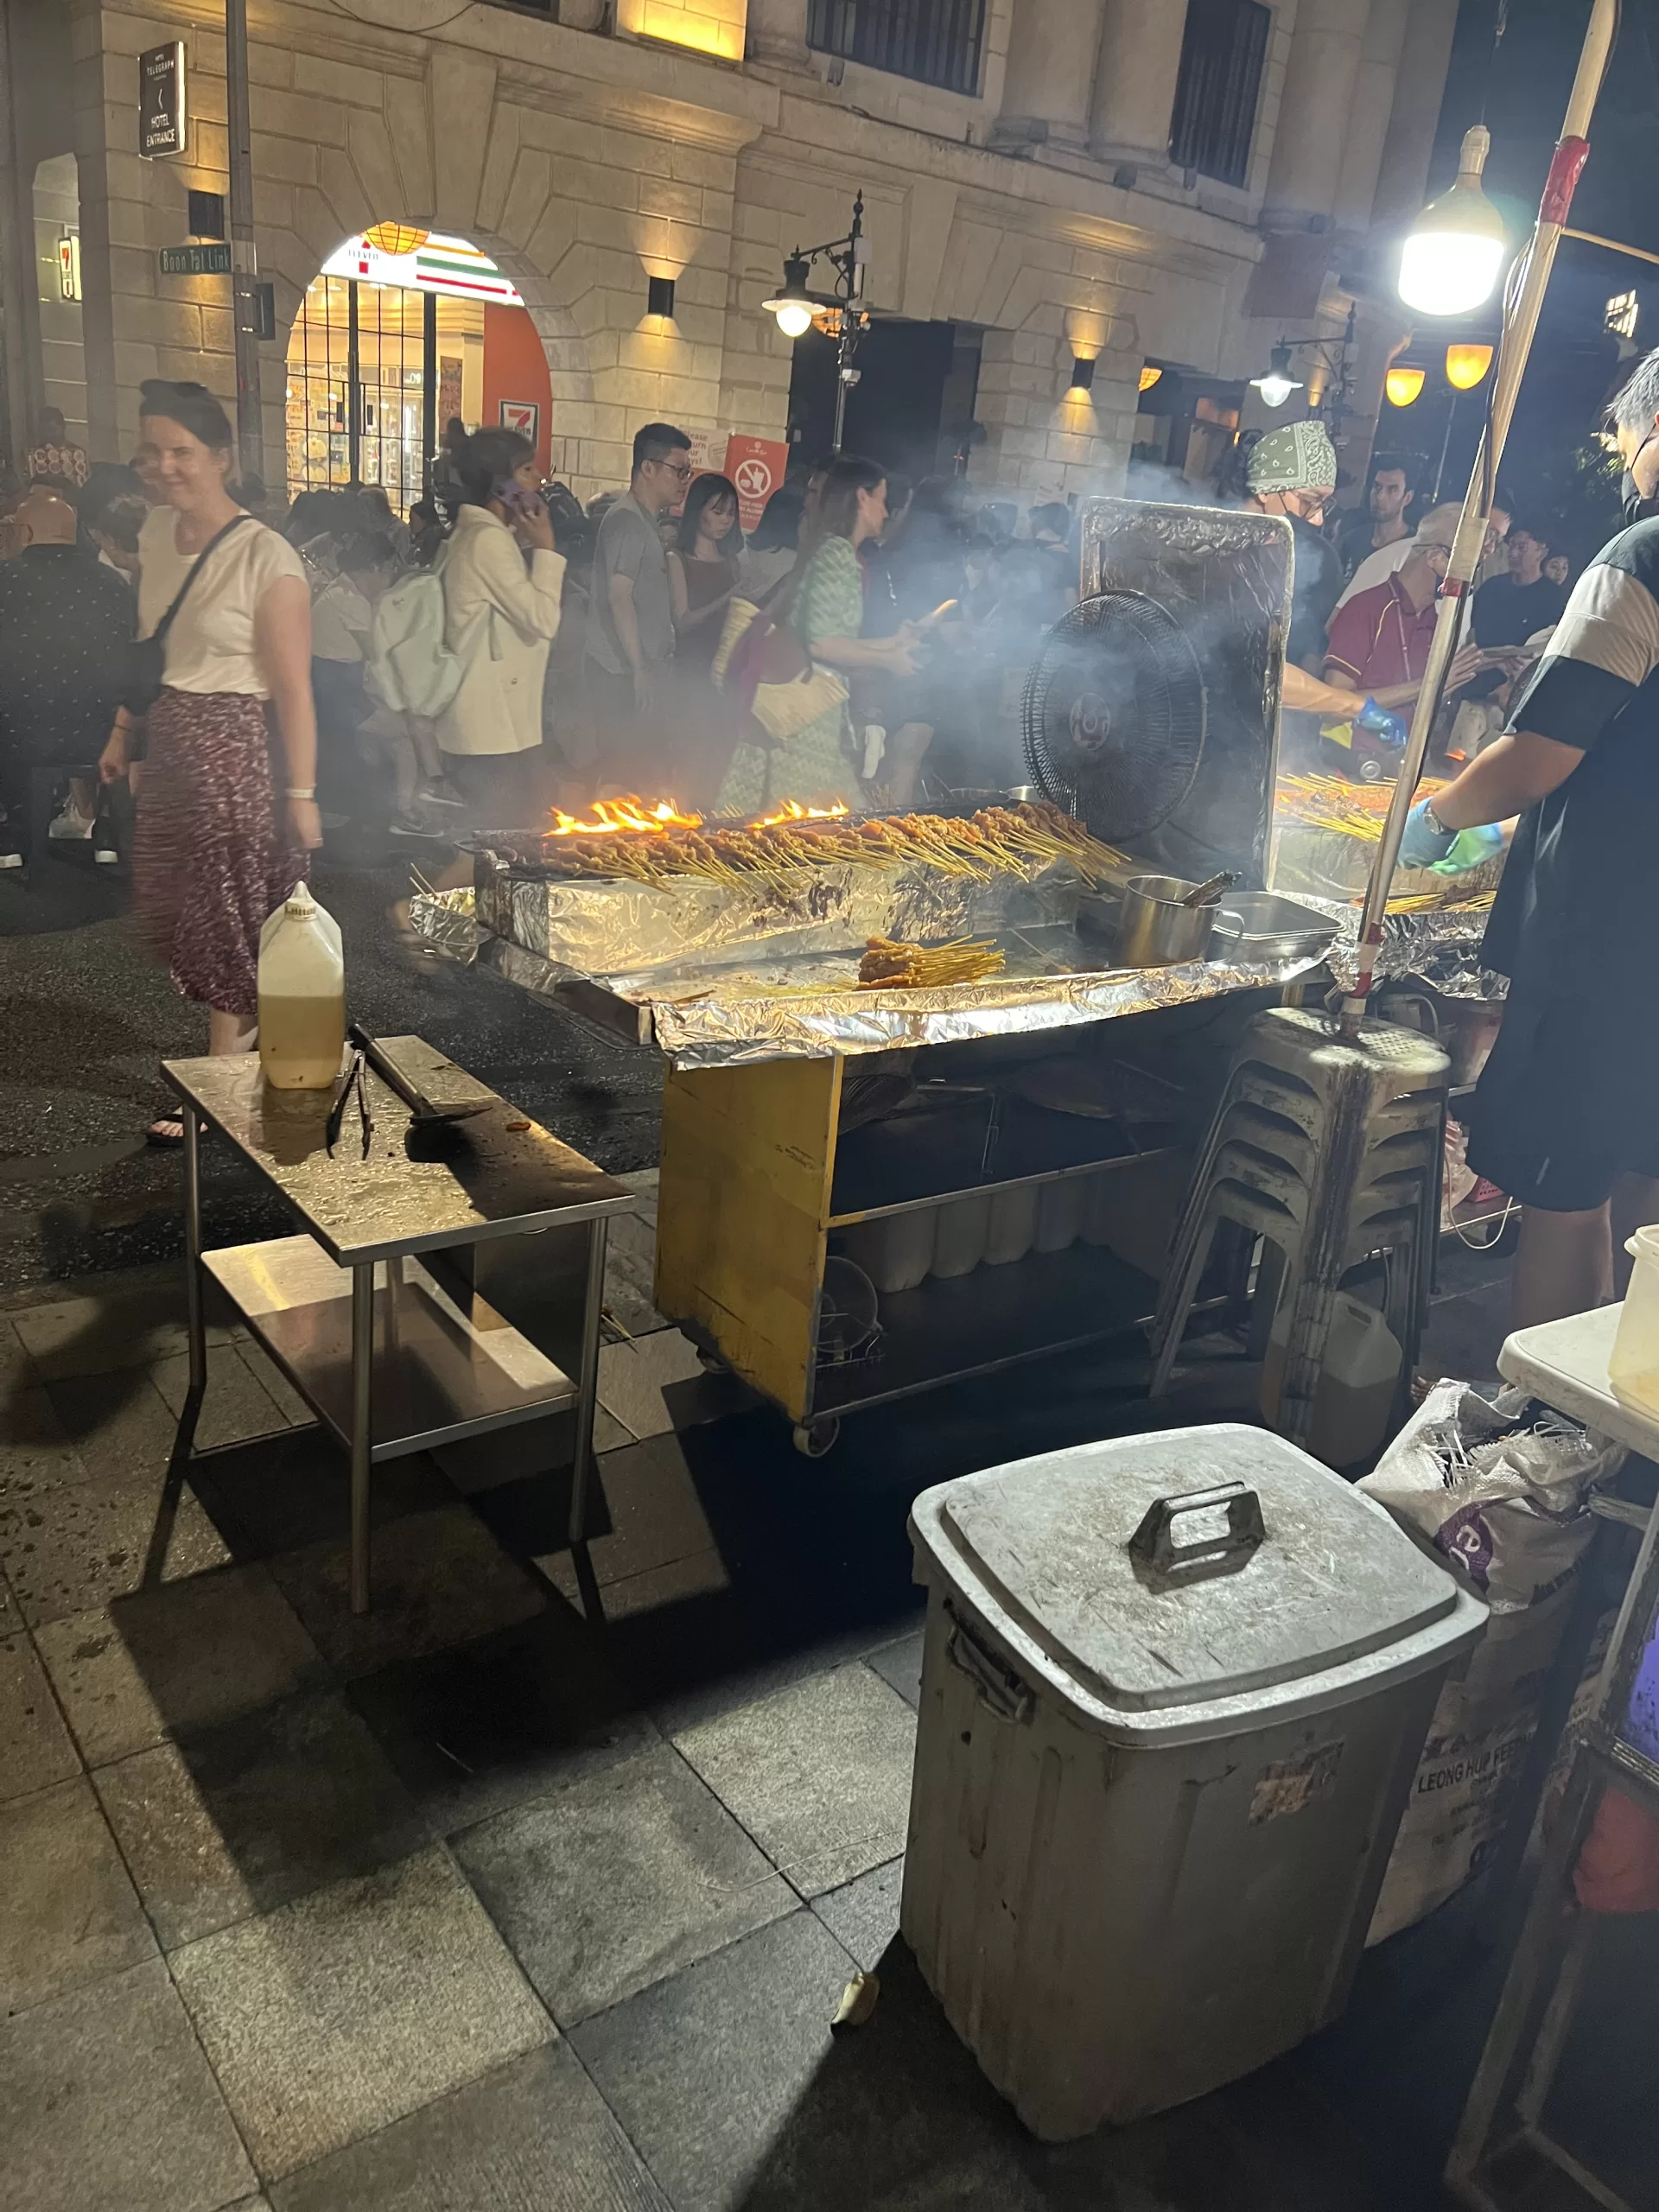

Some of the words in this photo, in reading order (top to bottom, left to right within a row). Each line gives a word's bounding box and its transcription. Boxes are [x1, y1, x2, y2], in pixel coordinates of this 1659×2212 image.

[151, 113, 169, 129] HOTEL
[147, 128, 175, 147] ENTRANCE
[162, 250, 187, 271] Boon
[189, 248, 205, 270] Tat
[208, 247, 231, 270] Link
[1418, 1763, 1464, 1795] LEONG
